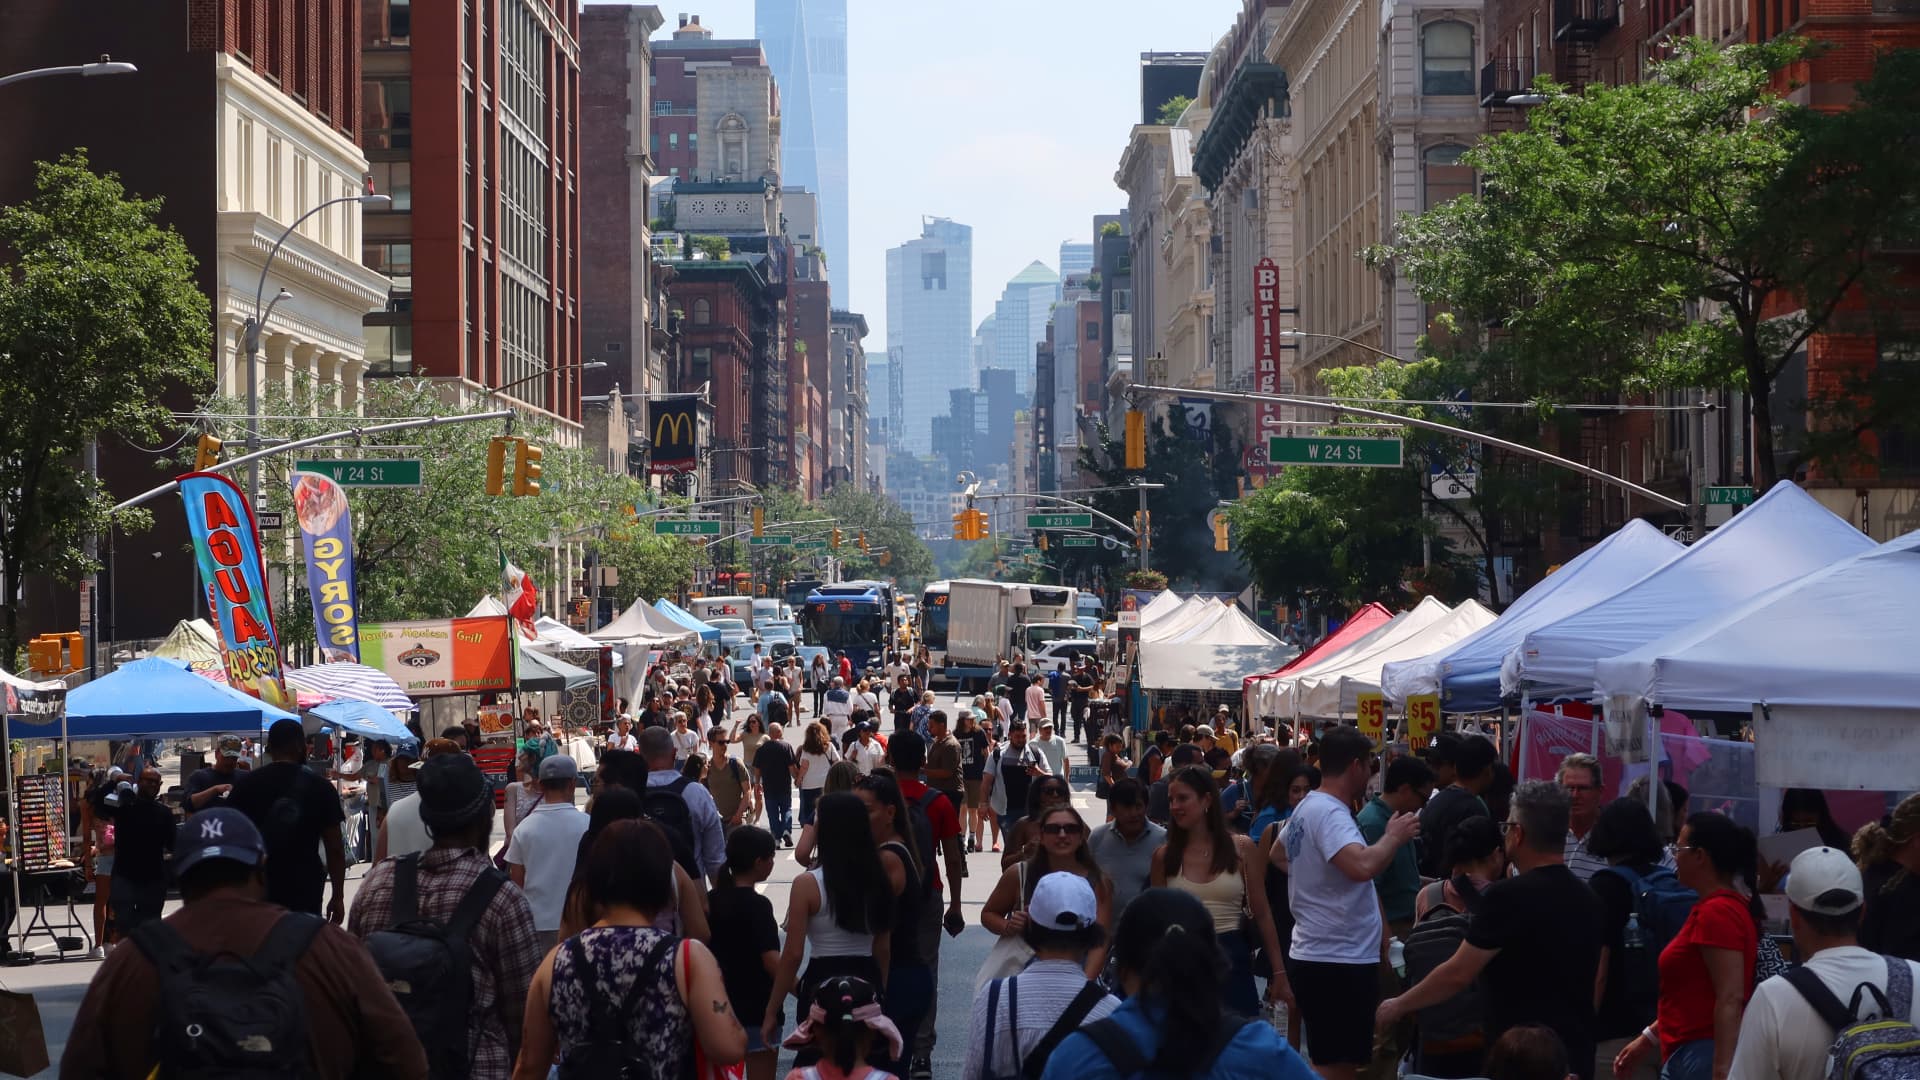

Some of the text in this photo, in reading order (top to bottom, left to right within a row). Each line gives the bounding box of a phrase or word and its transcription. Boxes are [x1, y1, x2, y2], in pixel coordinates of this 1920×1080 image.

[1308, 444, 1362, 460] W 24 St
[333, 467, 385, 481] W 24 St
[1709, 489, 1720, 502] W
[1725, 489, 1738, 502] 24
[259, 517, 277, 526] WAY
[1045, 517, 1052, 526] W
[1054, 517, 1062, 526] 23
[674, 525, 680, 533] W
[682, 525, 692, 533] 23
[707, 605, 738, 616] FedEx
[456, 629, 483, 644] Grill
[407, 680, 446, 690] BURRITOS
[1361, 699, 1384, 728] $5
[1411, 701, 1437, 733] $5
[1410, 737, 1428, 752] ON
[200, 817, 223, 839] NY
